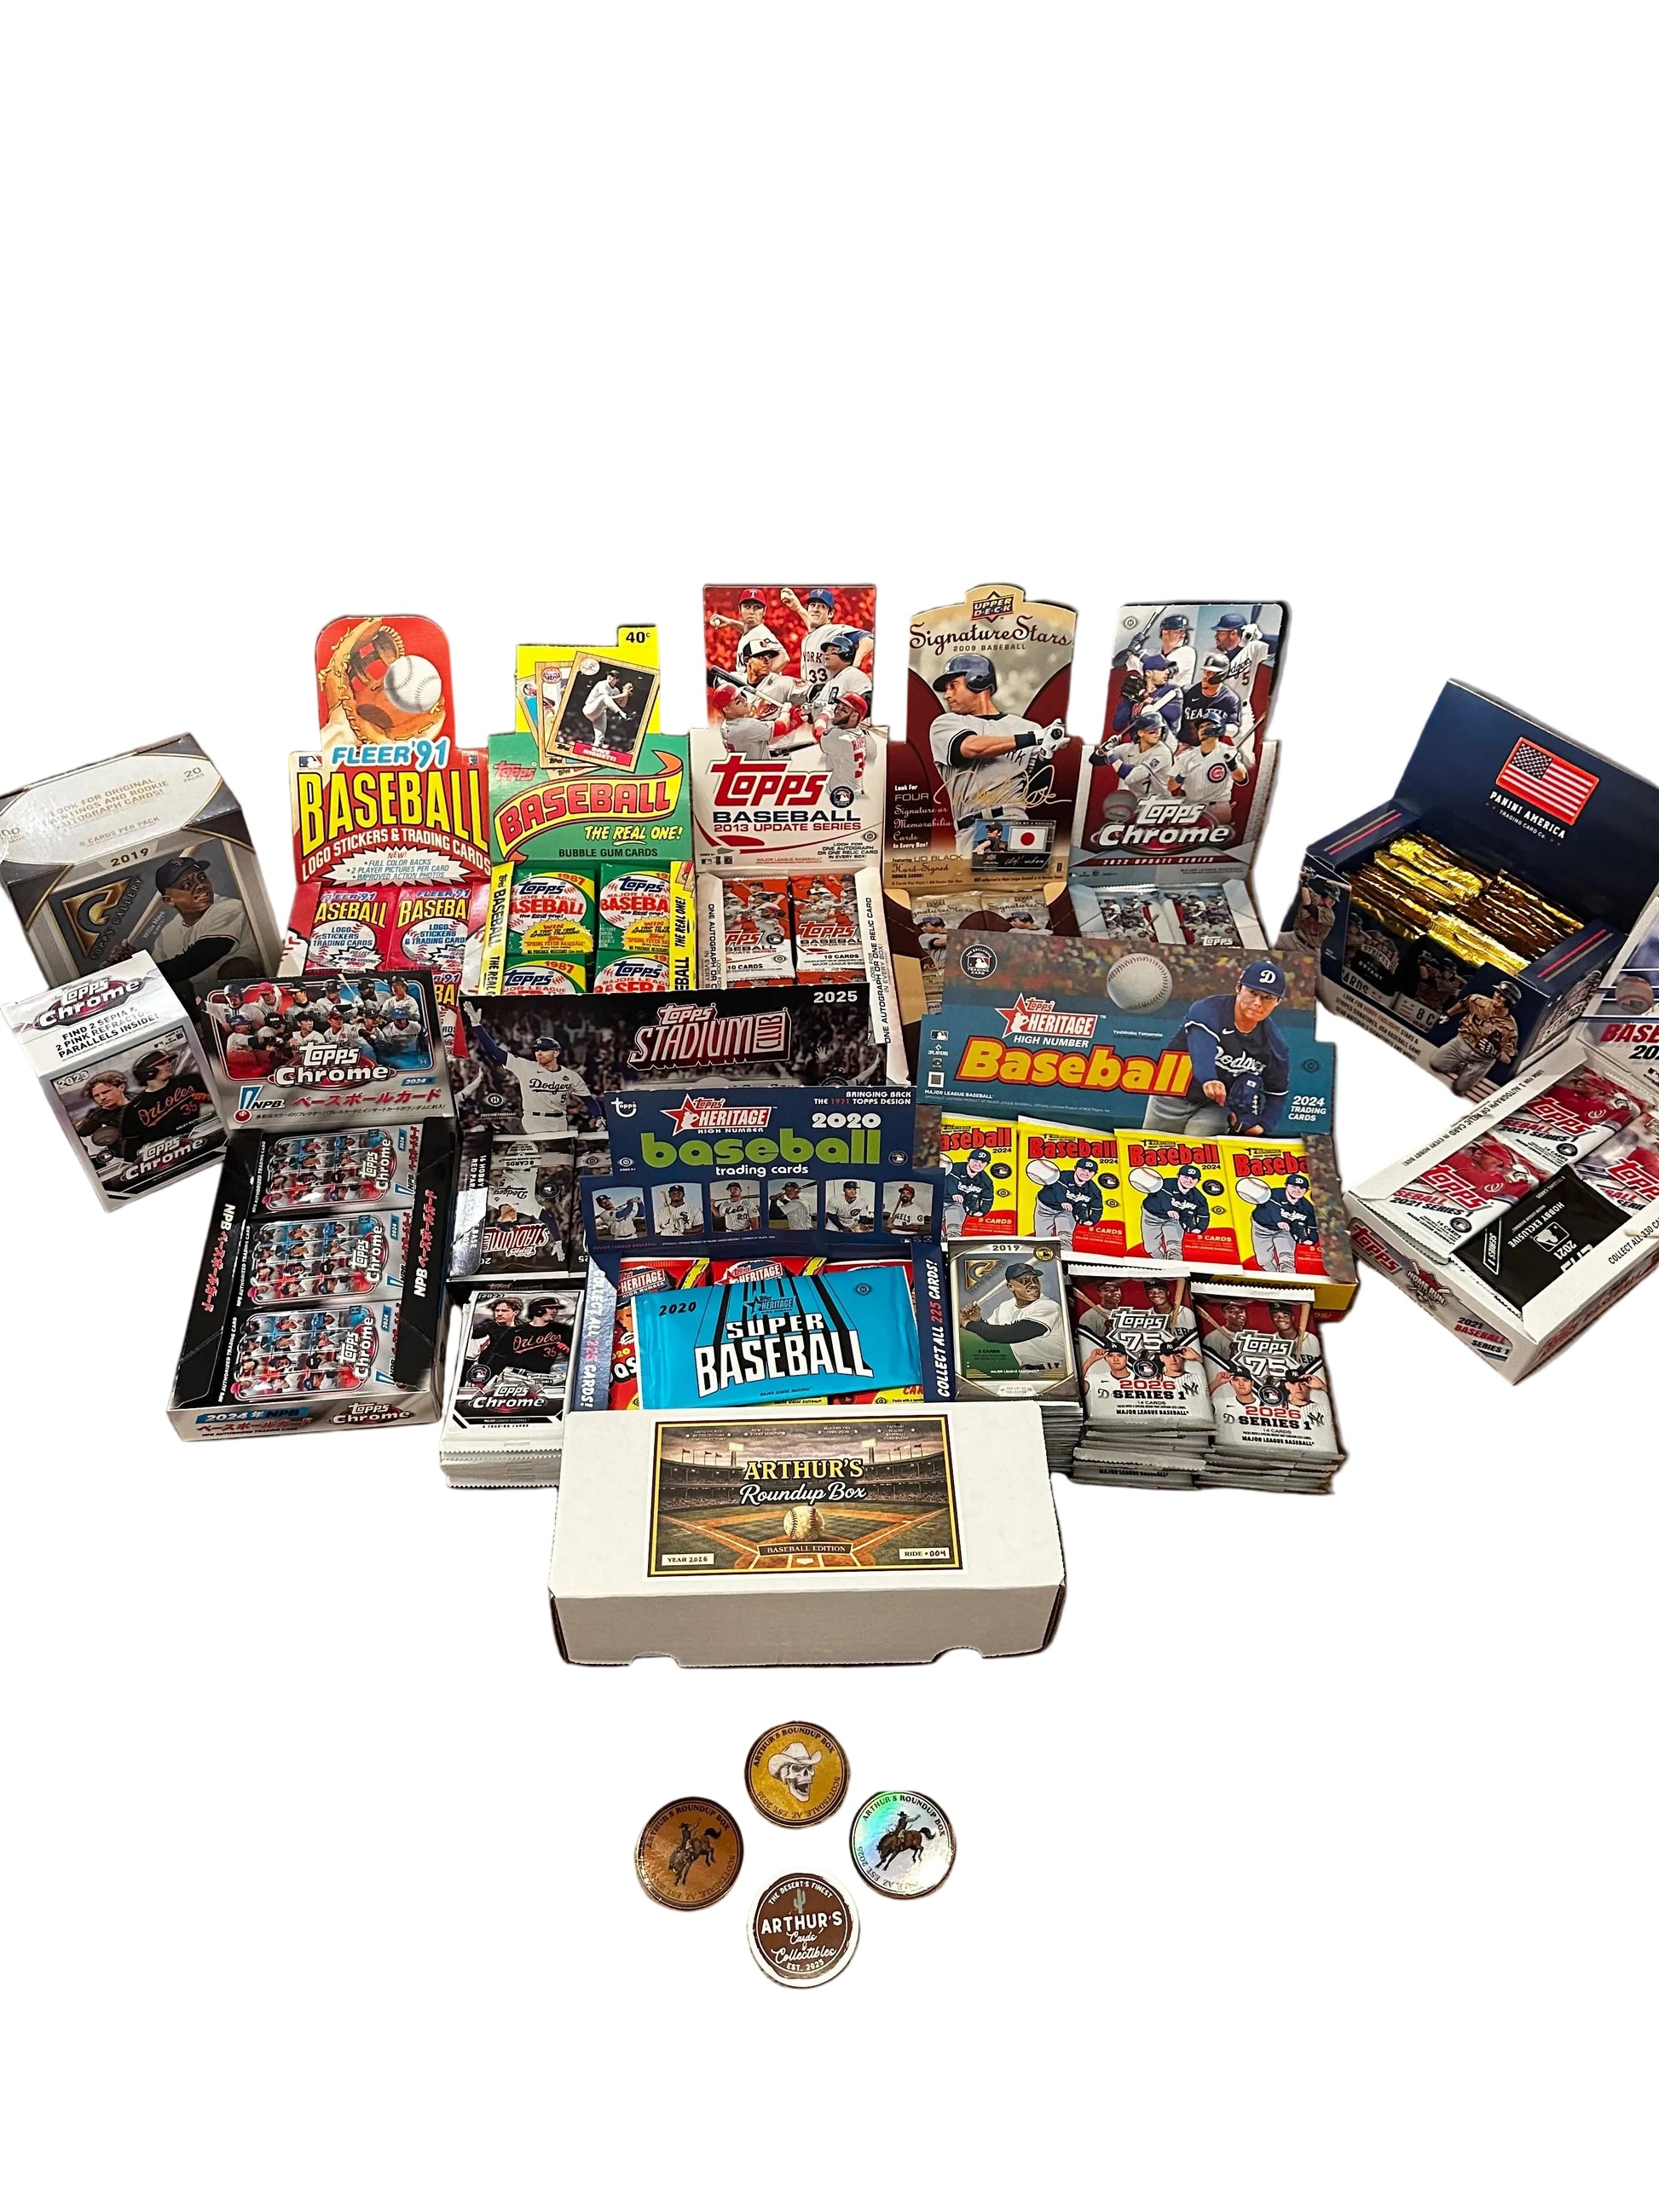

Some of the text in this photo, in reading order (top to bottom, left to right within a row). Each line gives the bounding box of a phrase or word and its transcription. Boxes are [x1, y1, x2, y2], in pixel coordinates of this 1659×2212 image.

[974, 598, 1011, 609] UPPER
[910, 615, 1072, 656] Signature Stars
[332, 747, 409, 764] FLEER
[184, 767, 201, 777] 20
[298, 770, 488, 858] BASEBALL
[500, 782, 670, 846] BASEBALL
[713, 811, 860, 823] BASEBALL
[893, 817, 951, 829] Memorabilia
[1489, 791, 1565, 838] PANINI AMERICA
[1500, 810, 1522, 825] TRADING
[1523, 823, 1537, 834] CARD
[585, 826, 682, 840] THE REAL ONE!
[1099, 825, 1228, 846] Chrome
[111, 848, 148, 867] 2019
[303, 829, 491, 881] LOGO STICKERS & TRADING CARDS
[557, 874, 585, 886] 1987
[39, 981, 141, 1024] Chrome
[813, 991, 857, 1002] 2025
[1027, 1014, 1096, 1036] HERITAGE
[629, 1016, 754, 1062] STADIUM
[1014, 1036, 1089, 1048] HIGH NUMBER
[275, 1066, 389, 1087] Chrome
[957, 1037, 1192, 1095] Baseball
[292, 1089, 442, 1106] ベースボールカード
[1293, 1096, 1324, 1106] 2024
[699, 1109, 767, 1127] HERITAGE
[812, 1113, 881, 1128] 2020
[640, 1129, 882, 1169] baseball
[1028, 1136, 1118, 1158] Baseball
[1128, 1145, 1220, 1167] Baseball
[126, 1138, 204, 1181] Chrome
[715, 1164, 808, 1177] trading cards
[1508, 1202, 1565, 1248] HOBBY EXCLUSIVE
[1553, 1240, 1577, 1260] 2021
[1608, 1227, 1654, 1264] COLLECT ALL 330
[621, 1269, 664, 1291] HERITAGE
[1408, 1271, 1445, 1305] HOME RUN
[659, 1302, 697, 1316] 2020
[726, 1313, 824, 1339] SUPER
[926, 1260, 950, 1397] COLLECT ALL 225 CARDS!
[1458, 1317, 1483, 1329] 2021
[1119, 1332, 1163, 1350] 75
[1454, 1325, 1506, 1344] BASEBALL
[355, 1317, 373, 1377] Chrome
[695, 1330, 874, 1398] BASEBALL
[1246, 1357, 1287, 1377] 75
[1113, 1390, 1186, 1400] SERIES 1
[1120, 1381, 1176, 1389] 2026
[473, 1396, 544, 1407] Chrome
[1246, 1406, 1301, 1418] 2026
[333, 1410, 409, 1424] Chrome
[1238, 1416, 1299, 1427] SERIES
[743, 1459, 864, 1481] ARTHUR'S
[740, 1482, 866, 1505] Roundup Box
[754, 1728, 835, 1767] ARTHUR'S ROUNDUP BOX
[676, 1805, 716, 1816] ROUNDUP
[716, 1814, 731, 1830] BOX
[863, 1795, 945, 1836] ARTHUR'S ROUNDUP BOX
[858, 1846, 868, 1867] 2025
[768, 1881, 833, 1905] THE DESERT'S FINEST
[761, 1911, 842, 1934] ARTHUR'S
[786, 1931, 817, 1944] Cards
[771, 1945, 836, 1964] Collectibles
[806, 1960, 824, 1970] 2025
